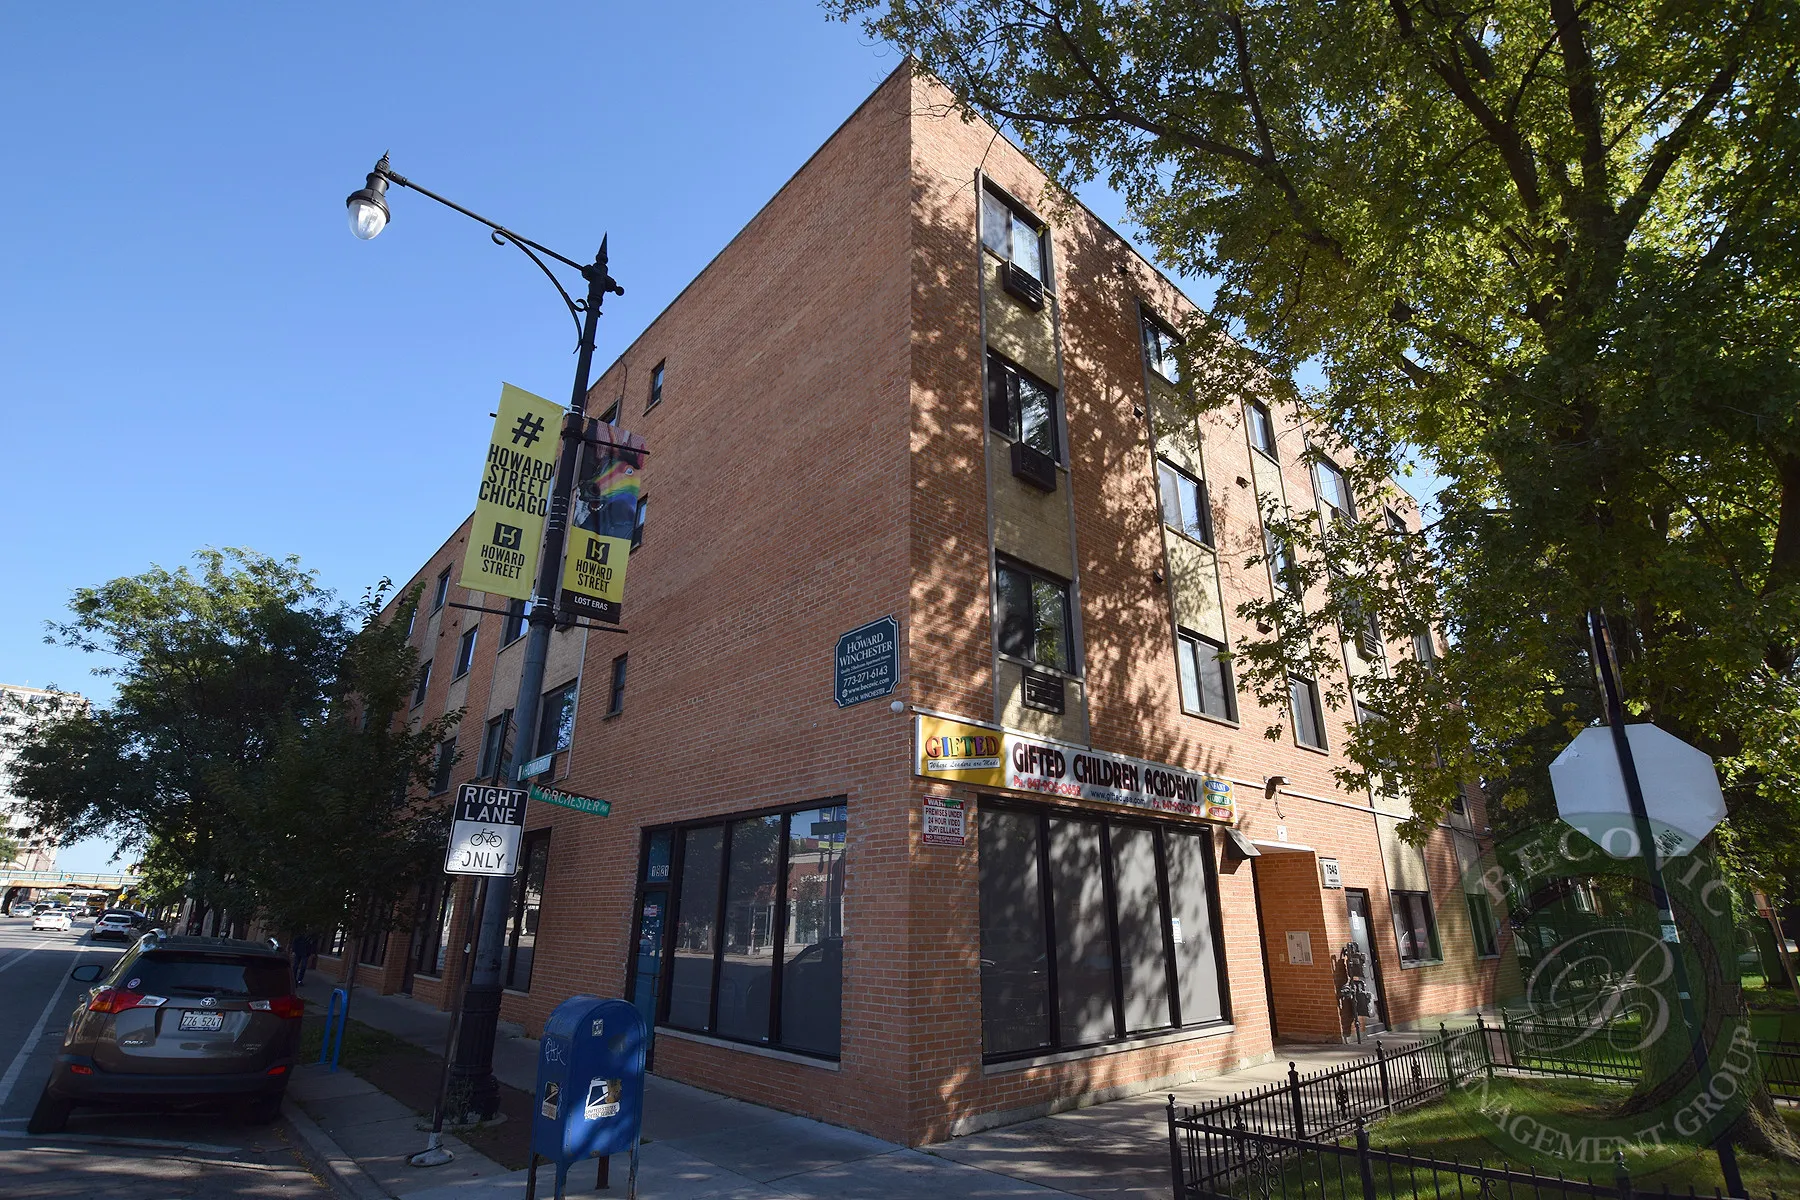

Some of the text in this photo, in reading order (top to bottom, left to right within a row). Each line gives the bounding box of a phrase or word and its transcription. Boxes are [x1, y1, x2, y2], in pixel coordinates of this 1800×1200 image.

[487, 444, 554, 482] HOWARD
[487, 464, 548, 498] STREET
[478, 481, 548, 517] CHICAGO
[480, 544, 526, 567] HOWARD
[481, 559, 523, 580] STREET
[575, 558, 613, 581] HOWARD
[577, 573, 610, 594] STREET
[574, 595, 609, 611] LOST ERAS
[839, 640, 893, 667] WINCHESTER
[846, 632, 884, 655] HOWARD
[843, 665, 888, 688] 773-271-6143
[925, 736, 1000, 758] GIFTED
[929, 761, 948, 769] Where
[1013, 742, 1199, 803] GIFTED CHILDREN ACADEMY
[464, 787, 522, 806] RIGHT
[927, 798, 960, 809] WARNG
[464, 804, 517, 825] LANE
[925, 807, 963, 819] PREMISES UNDER
[928, 816, 960, 827] 24 HOUR VIDEO
[928, 825, 960, 835] SURVEILLANCE
